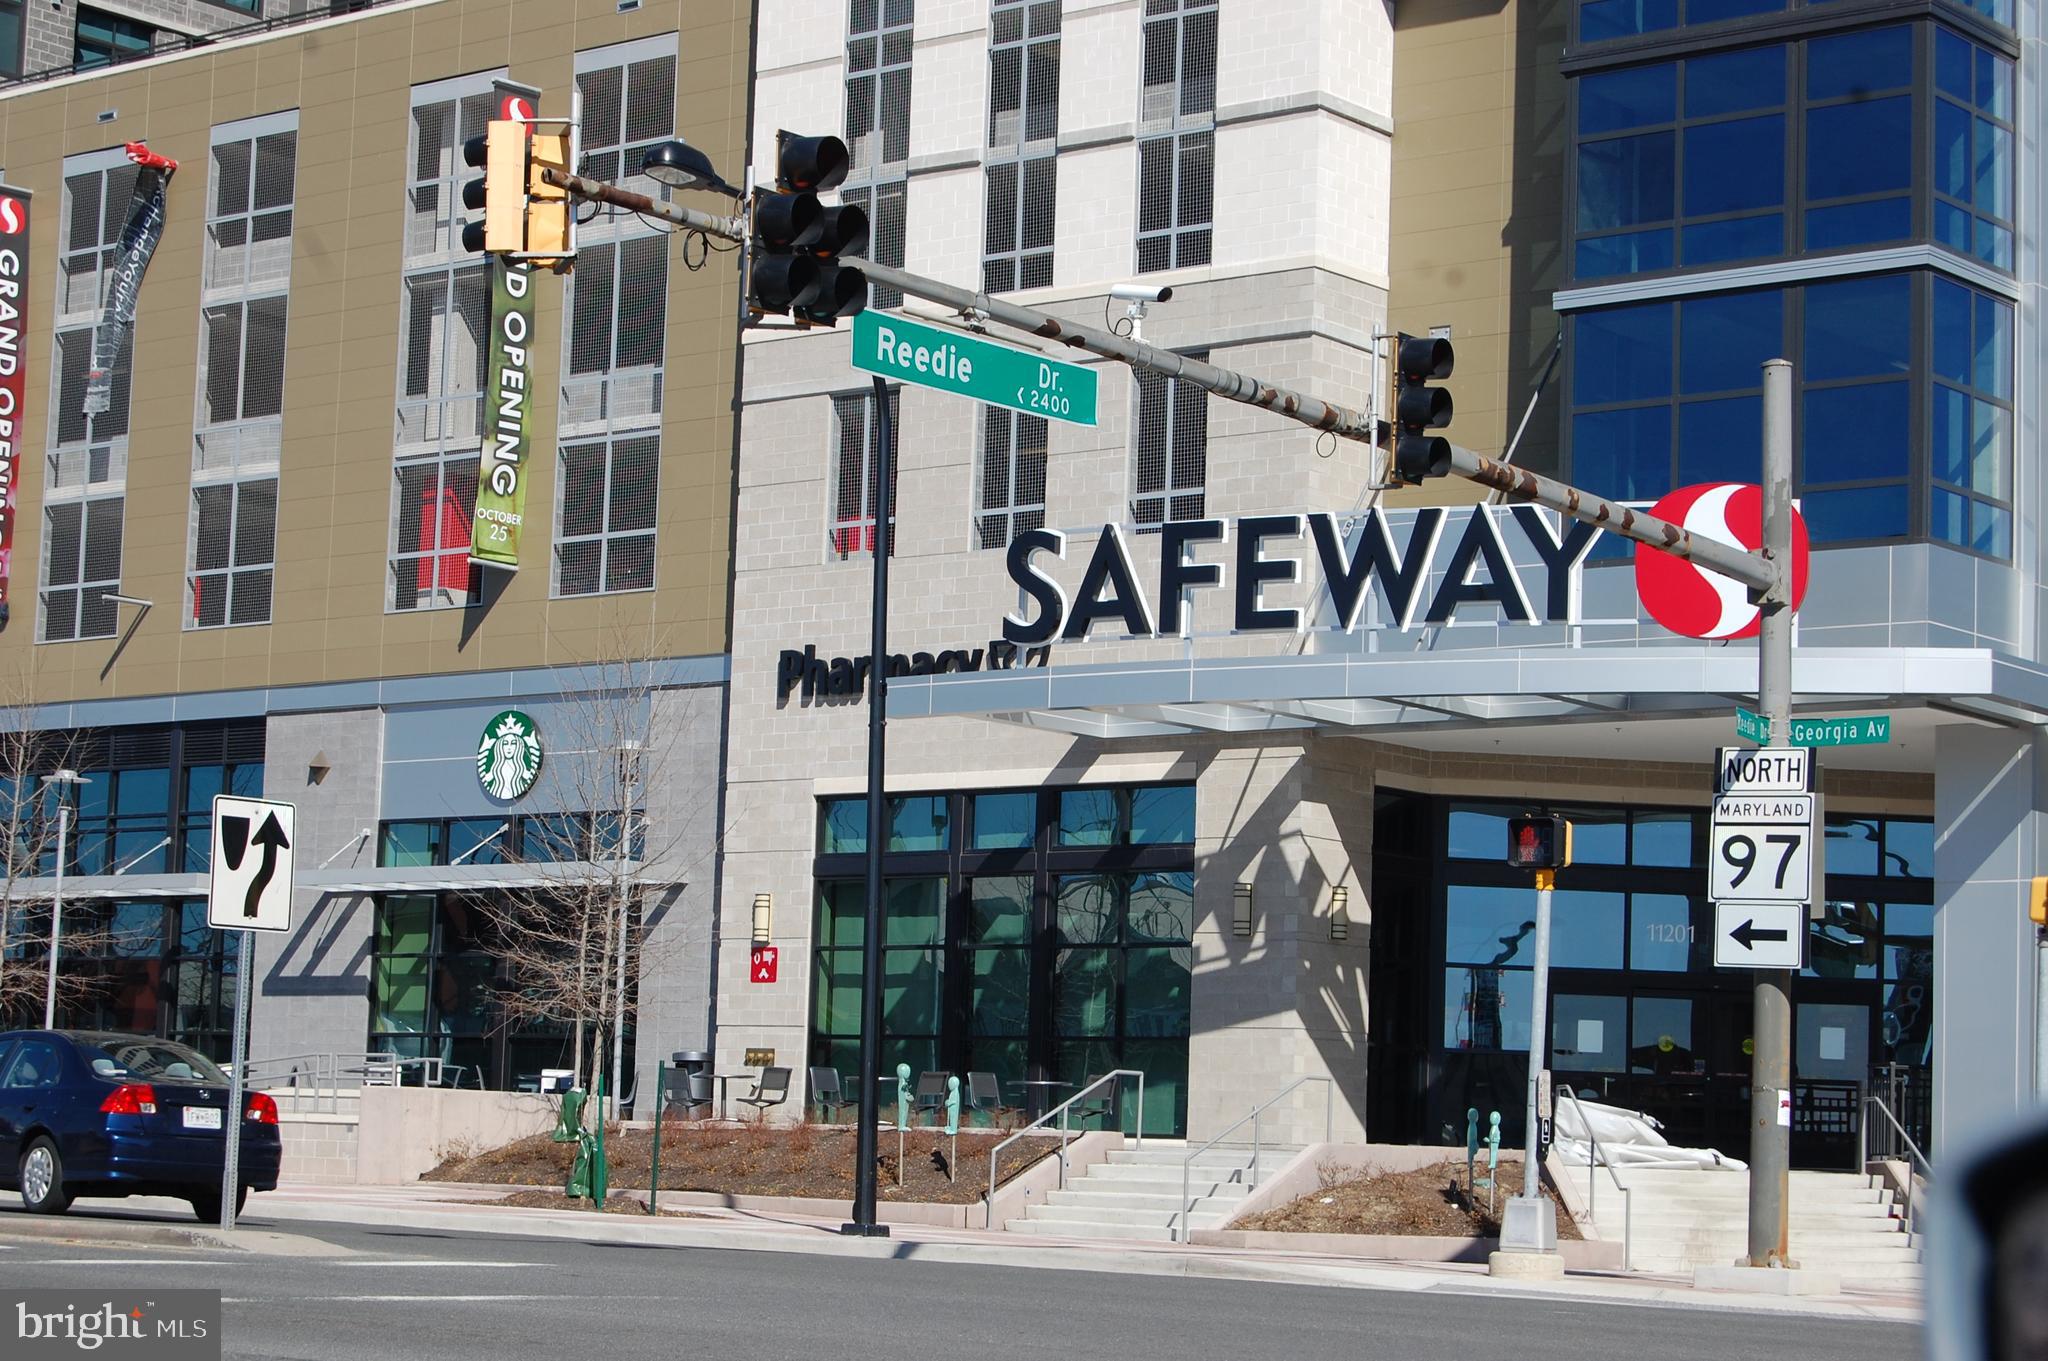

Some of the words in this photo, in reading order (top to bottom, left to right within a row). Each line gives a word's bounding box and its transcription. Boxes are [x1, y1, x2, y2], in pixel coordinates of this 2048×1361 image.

[0, 249, 19, 376] GRAND
[877, 326, 973, 384] Reedie
[1038, 362, 1063, 392] Dr.
[492, 310, 527, 497] OPENING
[1030, 390, 1070, 415] 2400
[477, 508, 522, 526] OCTOBER
[489, 524, 508, 542] 25
[1003, 502, 1605, 644] SAFEWAY
[1795, 722, 1857, 744] Georgia
[1866, 721, 1885, 738] Av
[1727, 758, 1801, 783] NORTH
[1720, 803, 1804, 817] MARYLAND
[1722, 834, 1801, 889] 97
[1646, 924, 1695, 943] 11201
